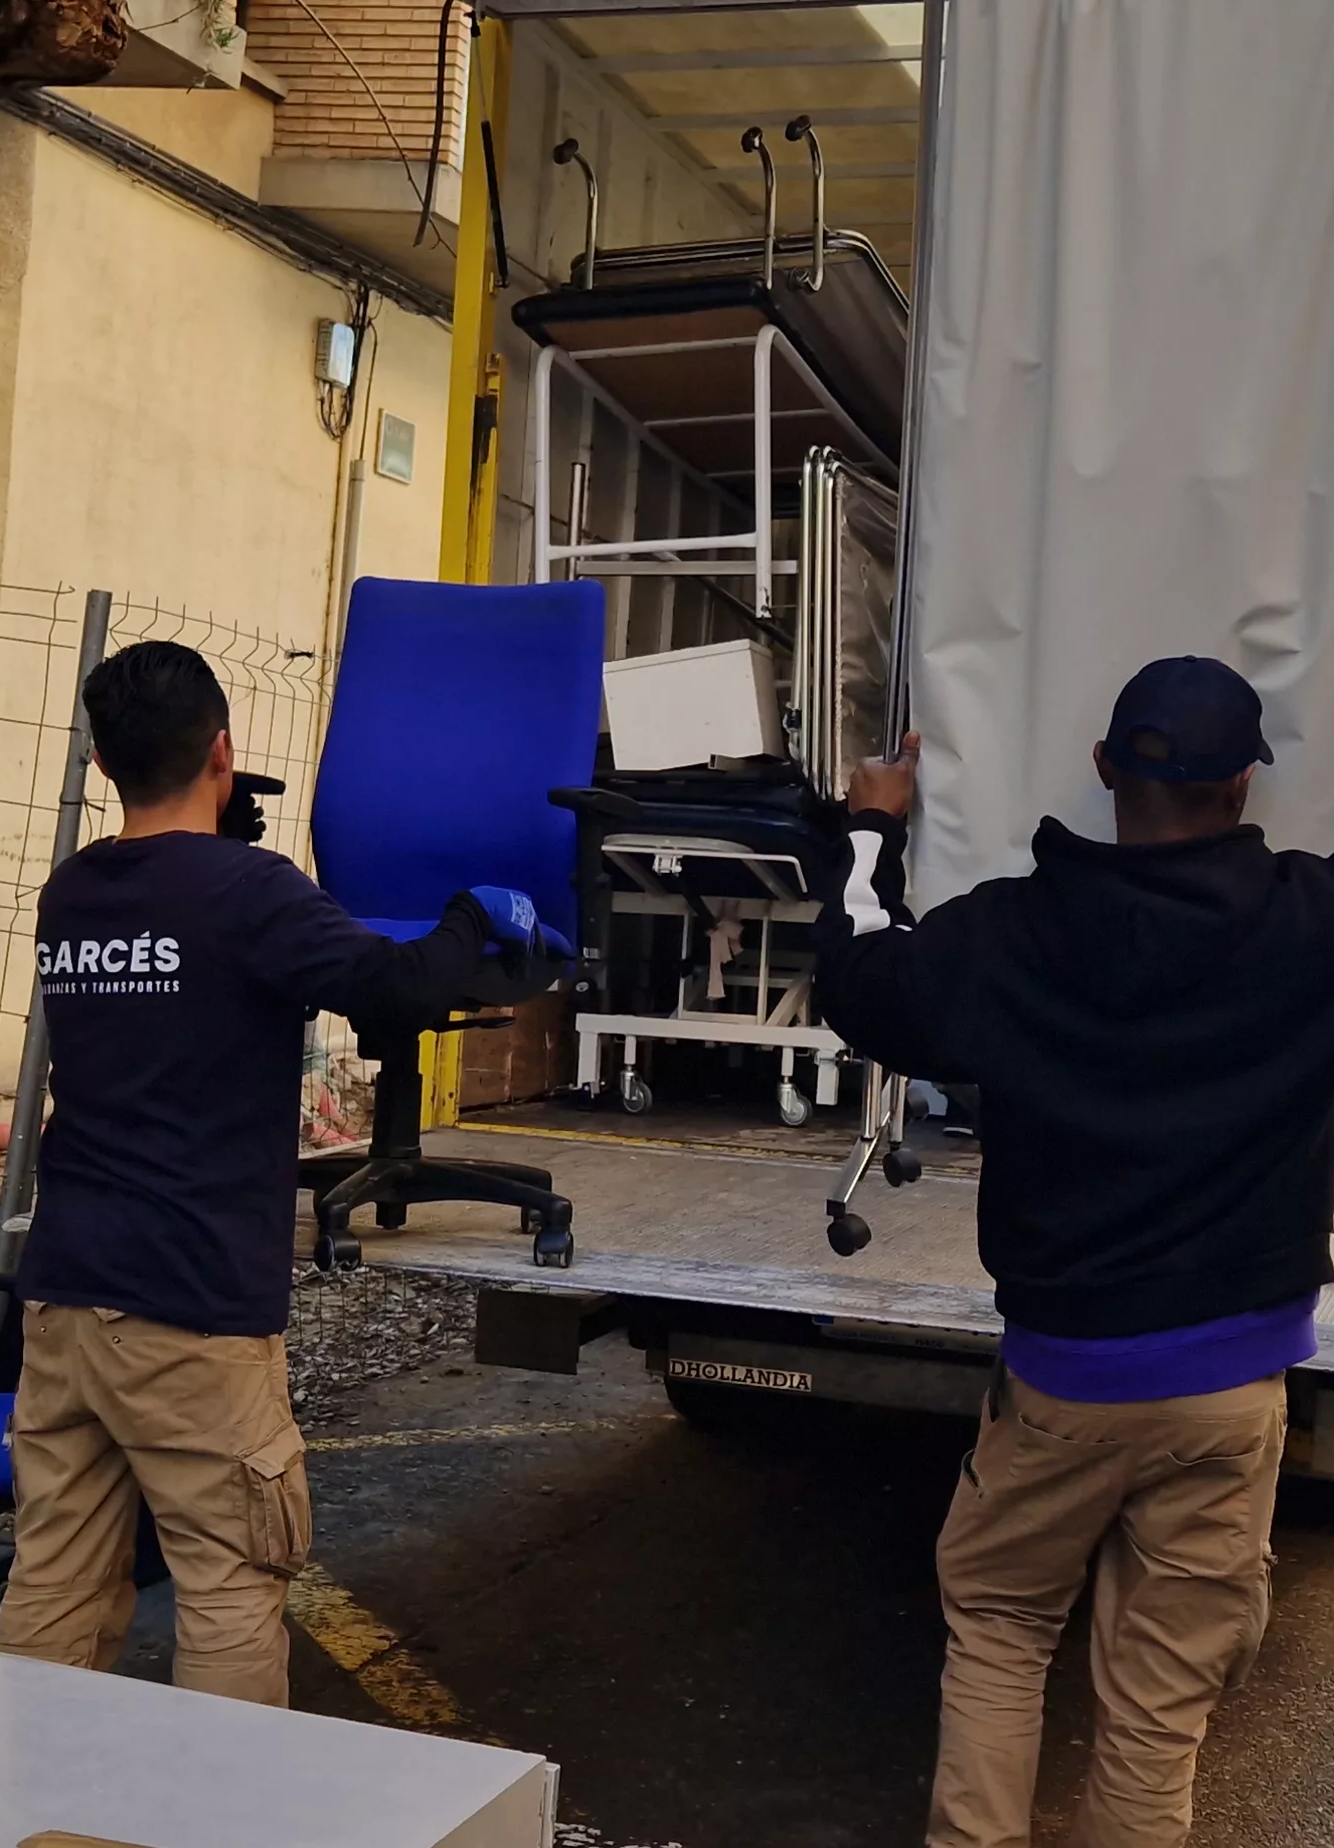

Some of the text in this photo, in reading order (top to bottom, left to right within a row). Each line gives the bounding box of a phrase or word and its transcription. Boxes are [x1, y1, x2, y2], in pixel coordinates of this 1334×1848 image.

[36, 931, 181, 975] GARCÉS
[80, 982, 87, 994] Y
[92, 980, 180, 994] TRANSPORTES
[670, 1360, 810, 1391] DHOLLANDIA
